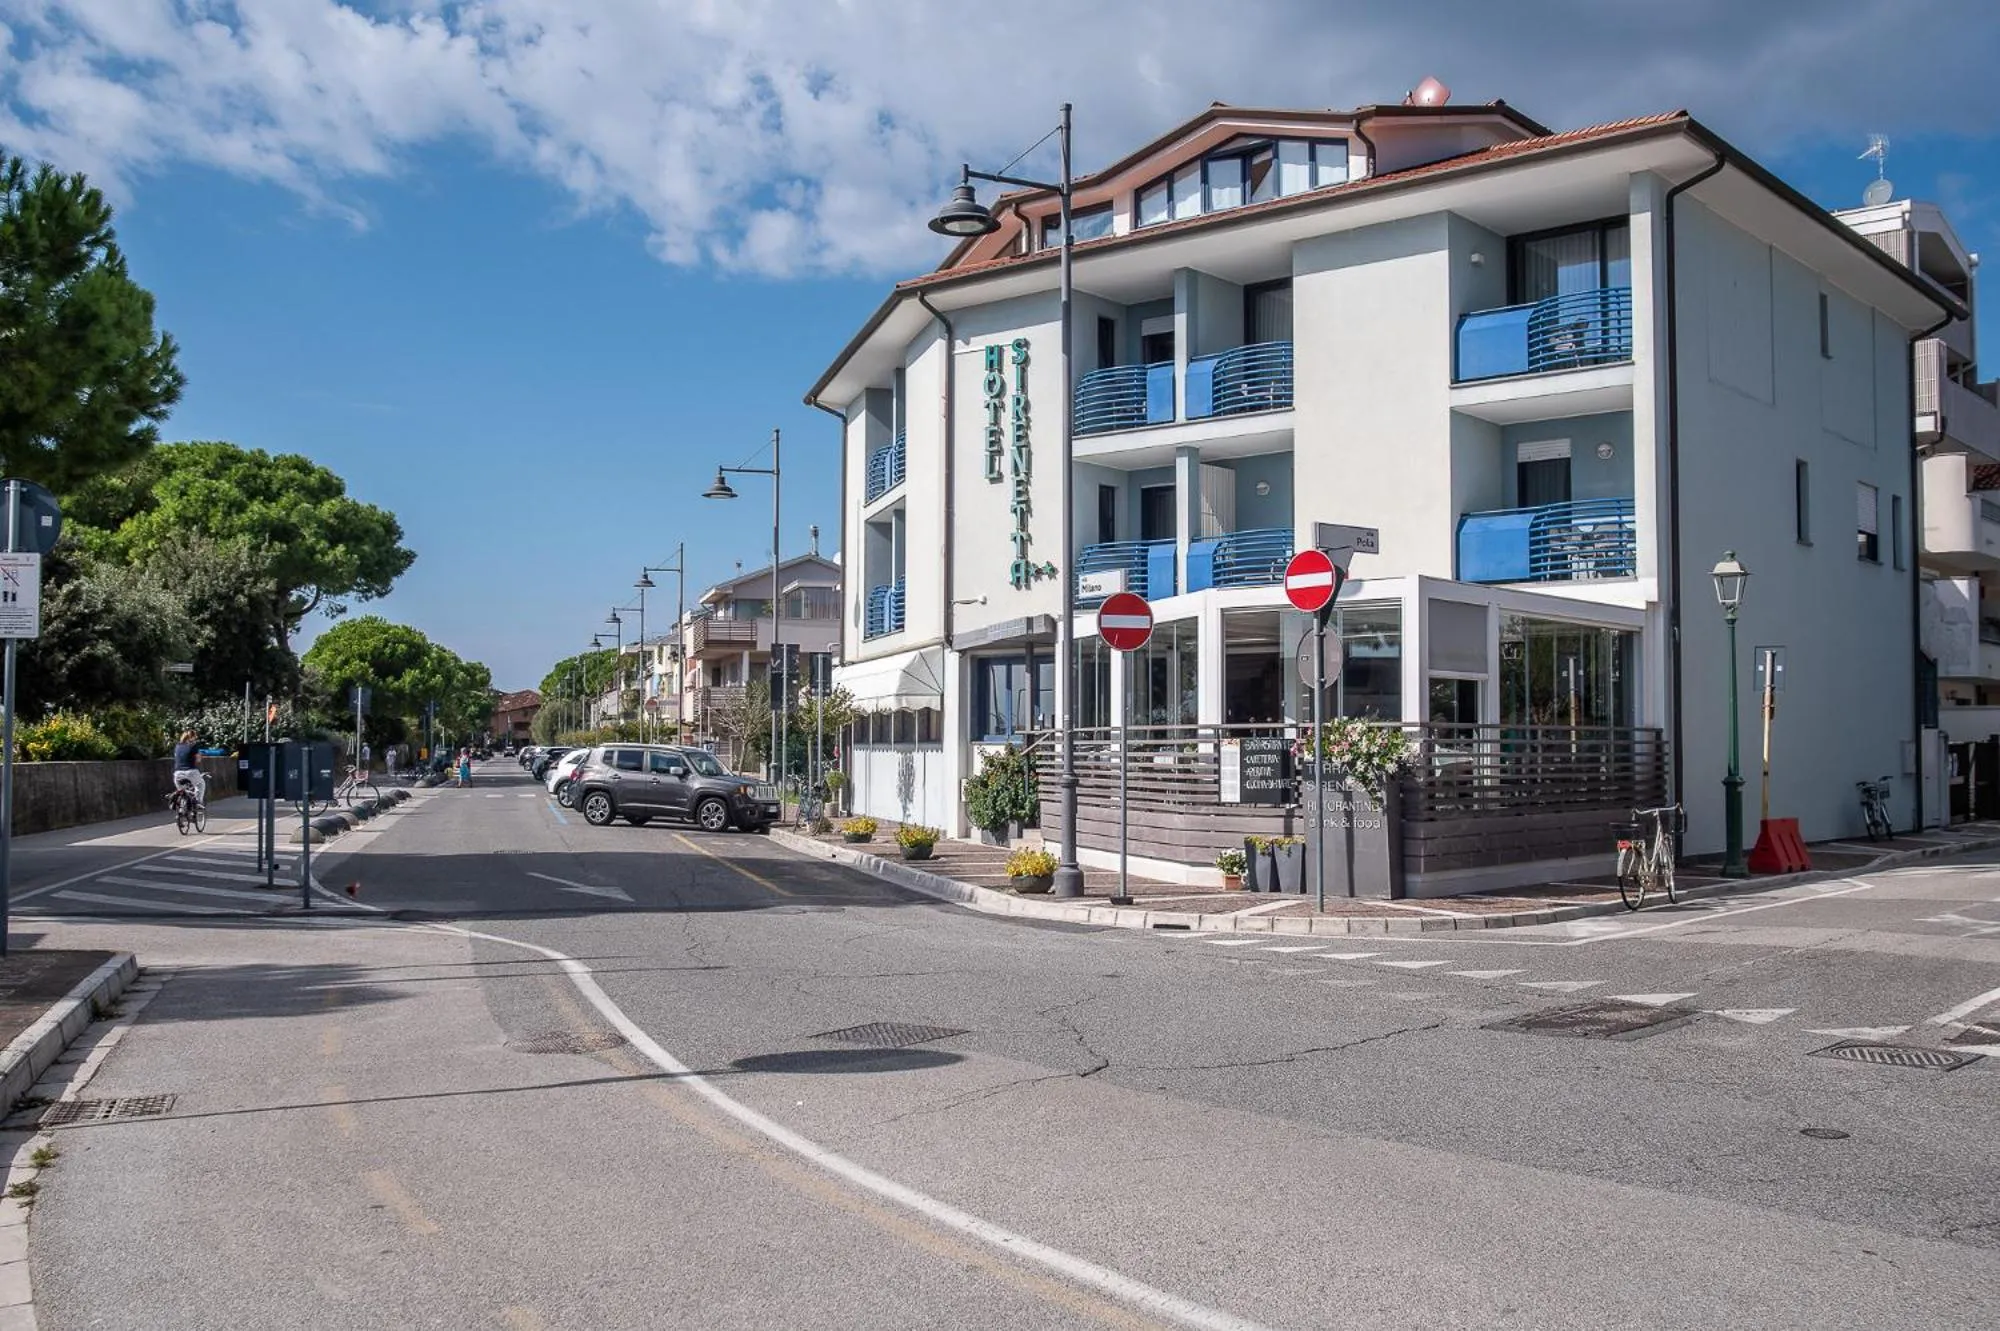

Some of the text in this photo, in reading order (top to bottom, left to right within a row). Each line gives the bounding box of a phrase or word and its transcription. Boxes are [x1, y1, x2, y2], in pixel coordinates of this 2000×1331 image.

[984, 344, 1005, 483] HOTEL
[1010, 338, 1032, 591] SIRENETTA
[1356, 537, 1374, 547] Pola
[1082, 583, 1102, 593] Milano
[1354, 816, 1381, 828] food
